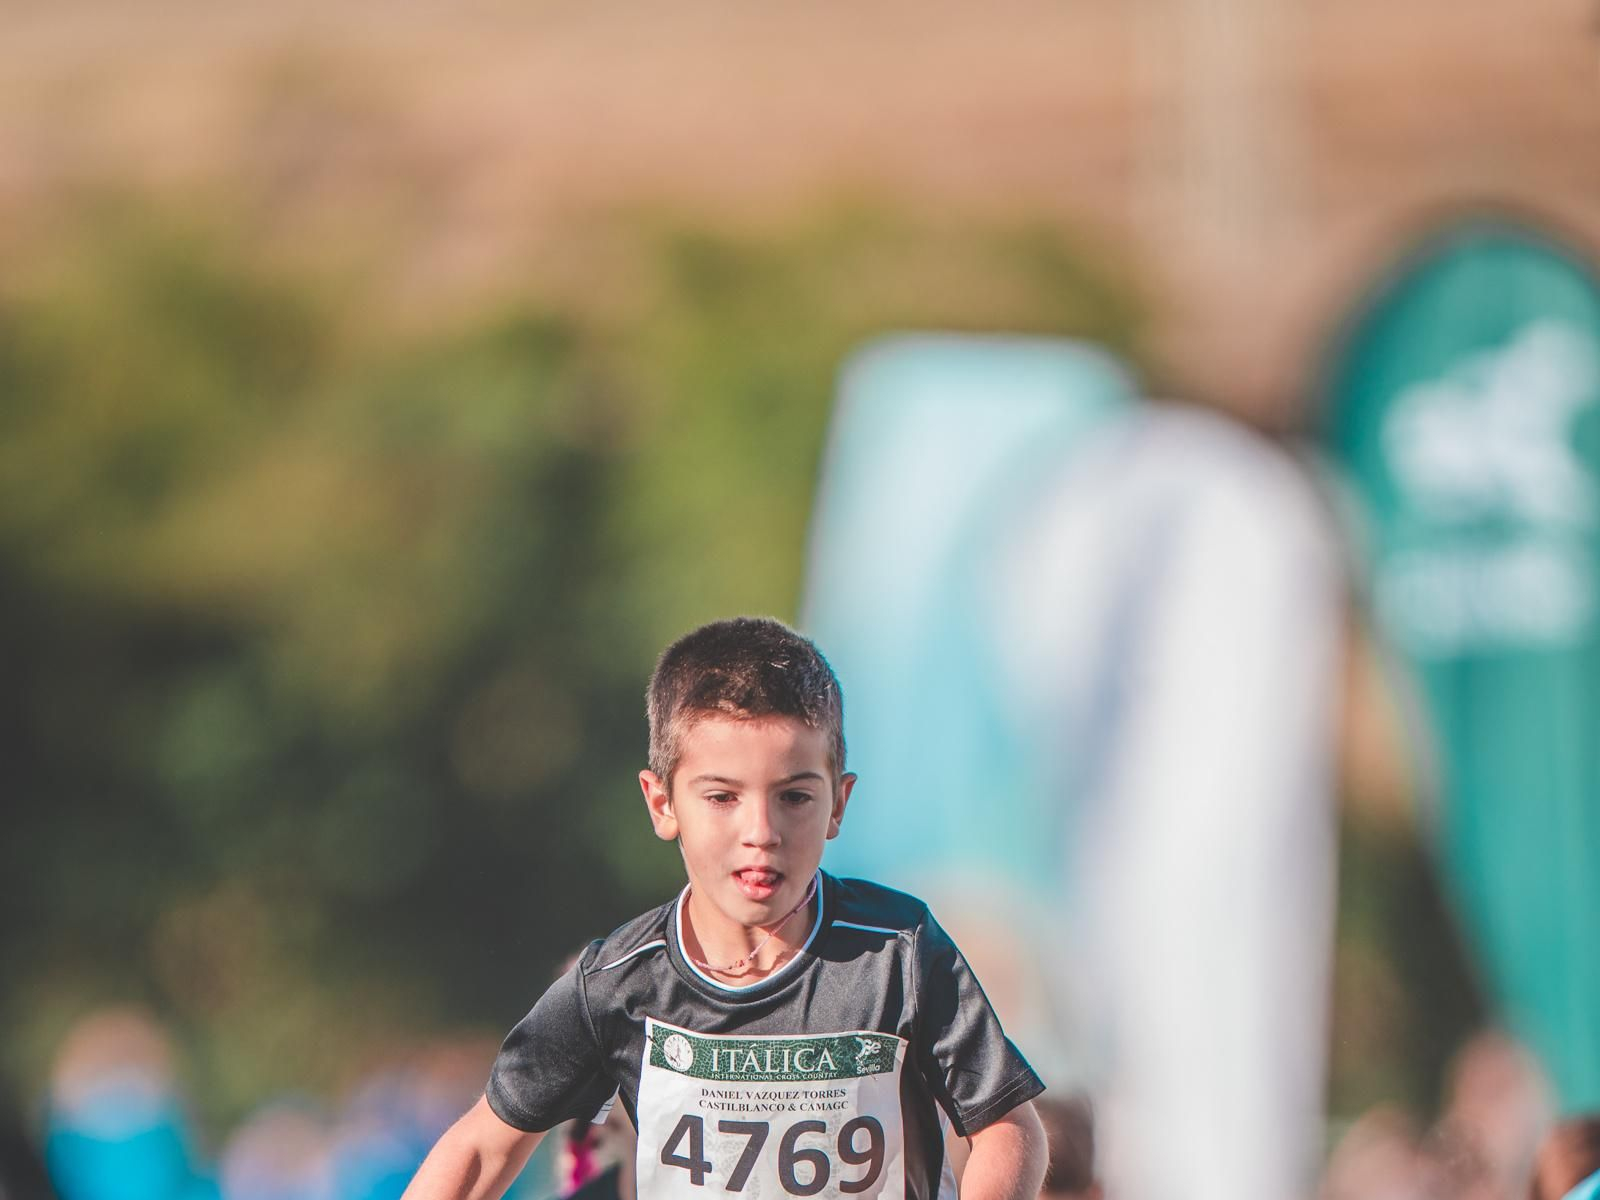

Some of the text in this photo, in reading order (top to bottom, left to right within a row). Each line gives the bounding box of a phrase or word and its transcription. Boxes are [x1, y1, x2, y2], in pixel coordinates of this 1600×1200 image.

[711, 1043, 838, 1073] ITÁLICA
[711, 1071, 838, 1081] INTERNATIONAL CROSS COUNTRY
[701, 1088, 847, 1101] DANIEL VAZQUEZ TORRES
[699, 1100, 785, 1112] CASTILBLANCO
[788, 1103, 797, 1112] &
[660, 1113, 886, 1197] 4769
